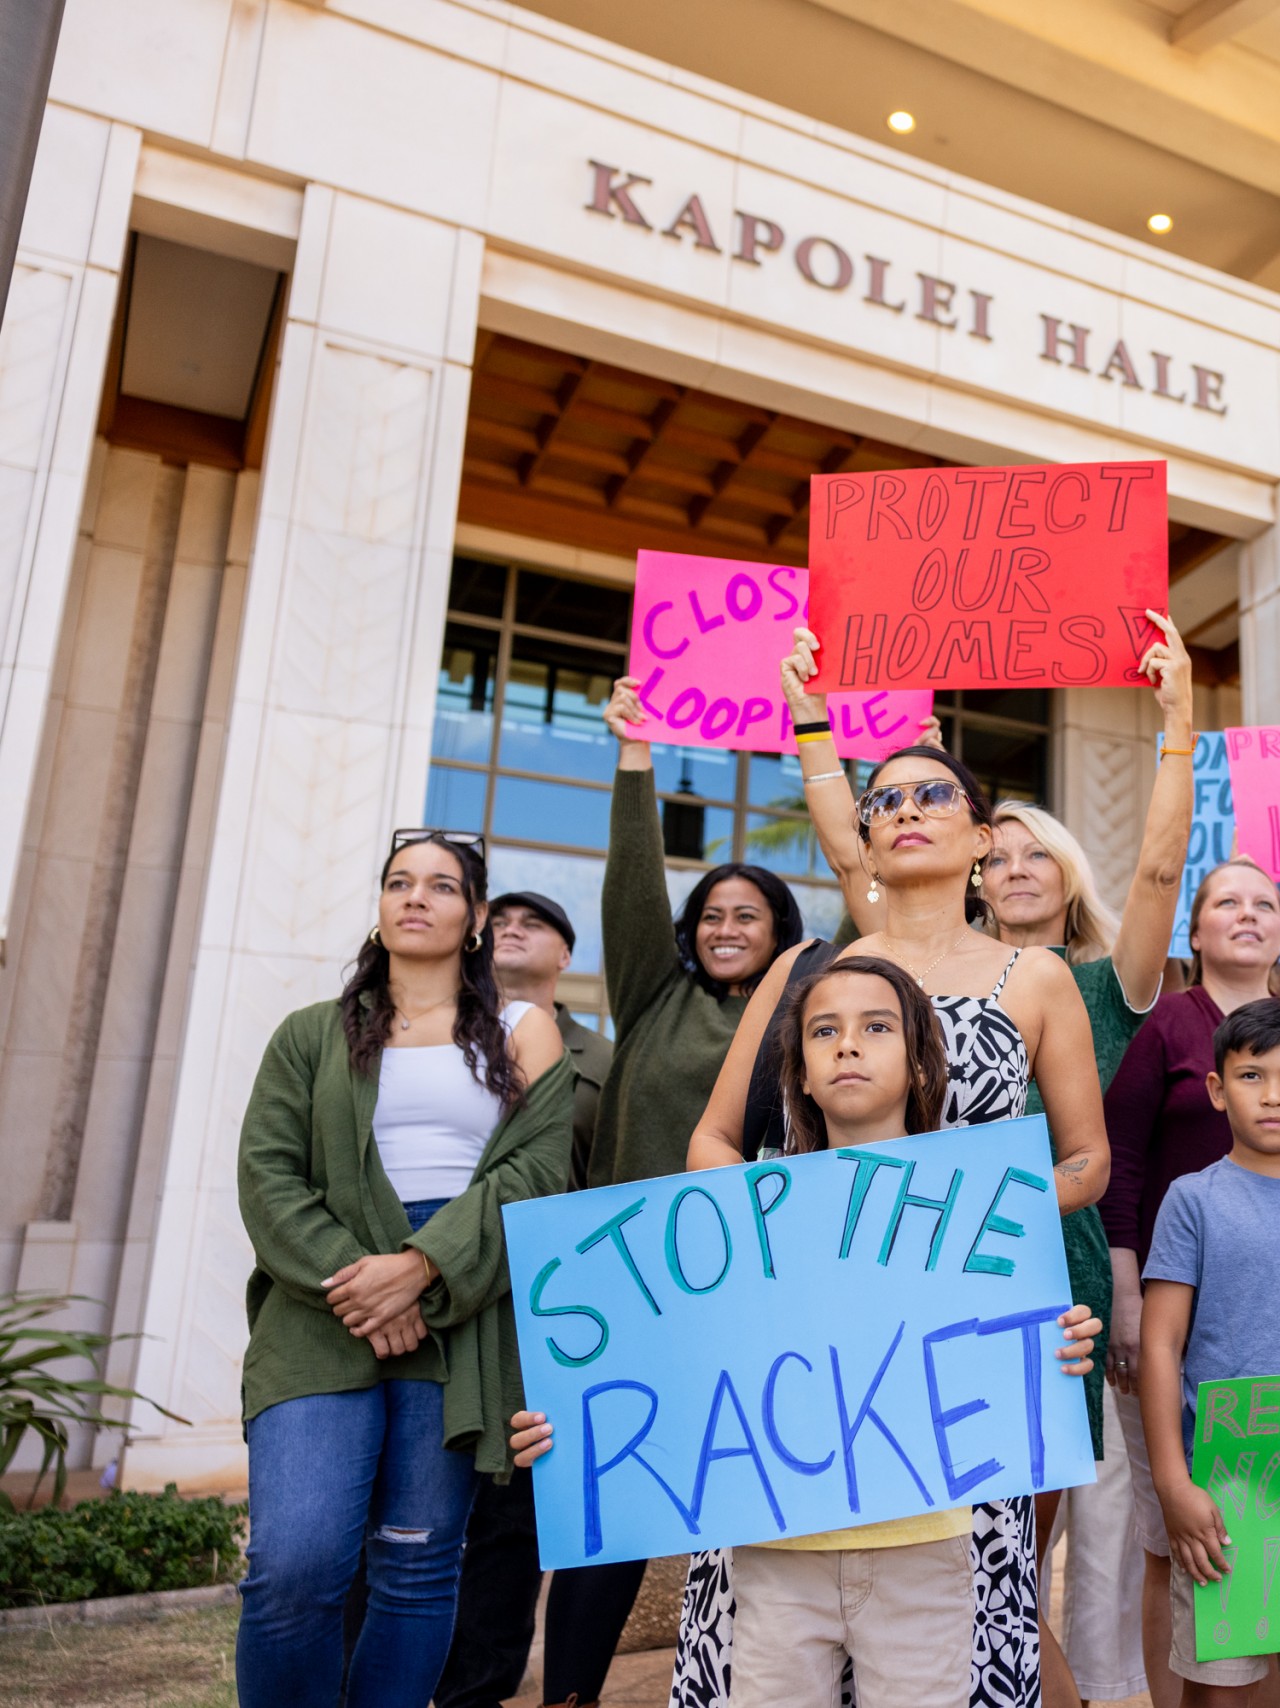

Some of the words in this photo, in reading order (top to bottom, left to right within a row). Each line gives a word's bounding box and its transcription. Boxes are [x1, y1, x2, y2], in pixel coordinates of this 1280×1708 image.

[585, 159, 993, 341] KAPOLEI
[1039, 314, 1228, 417] HALE
[826, 466, 1154, 541] PROTECT
[643, 567, 808, 660] CLOS
[912, 547, 1051, 613] OUR
[839, 606, 1164, 686] HOMES!
[640, 667, 908, 740] LOOPLE
[531, 1163, 792, 1368] STOP
[837, 1148, 1049, 1277] THE
[582, 1304, 1074, 1557] RACKET
